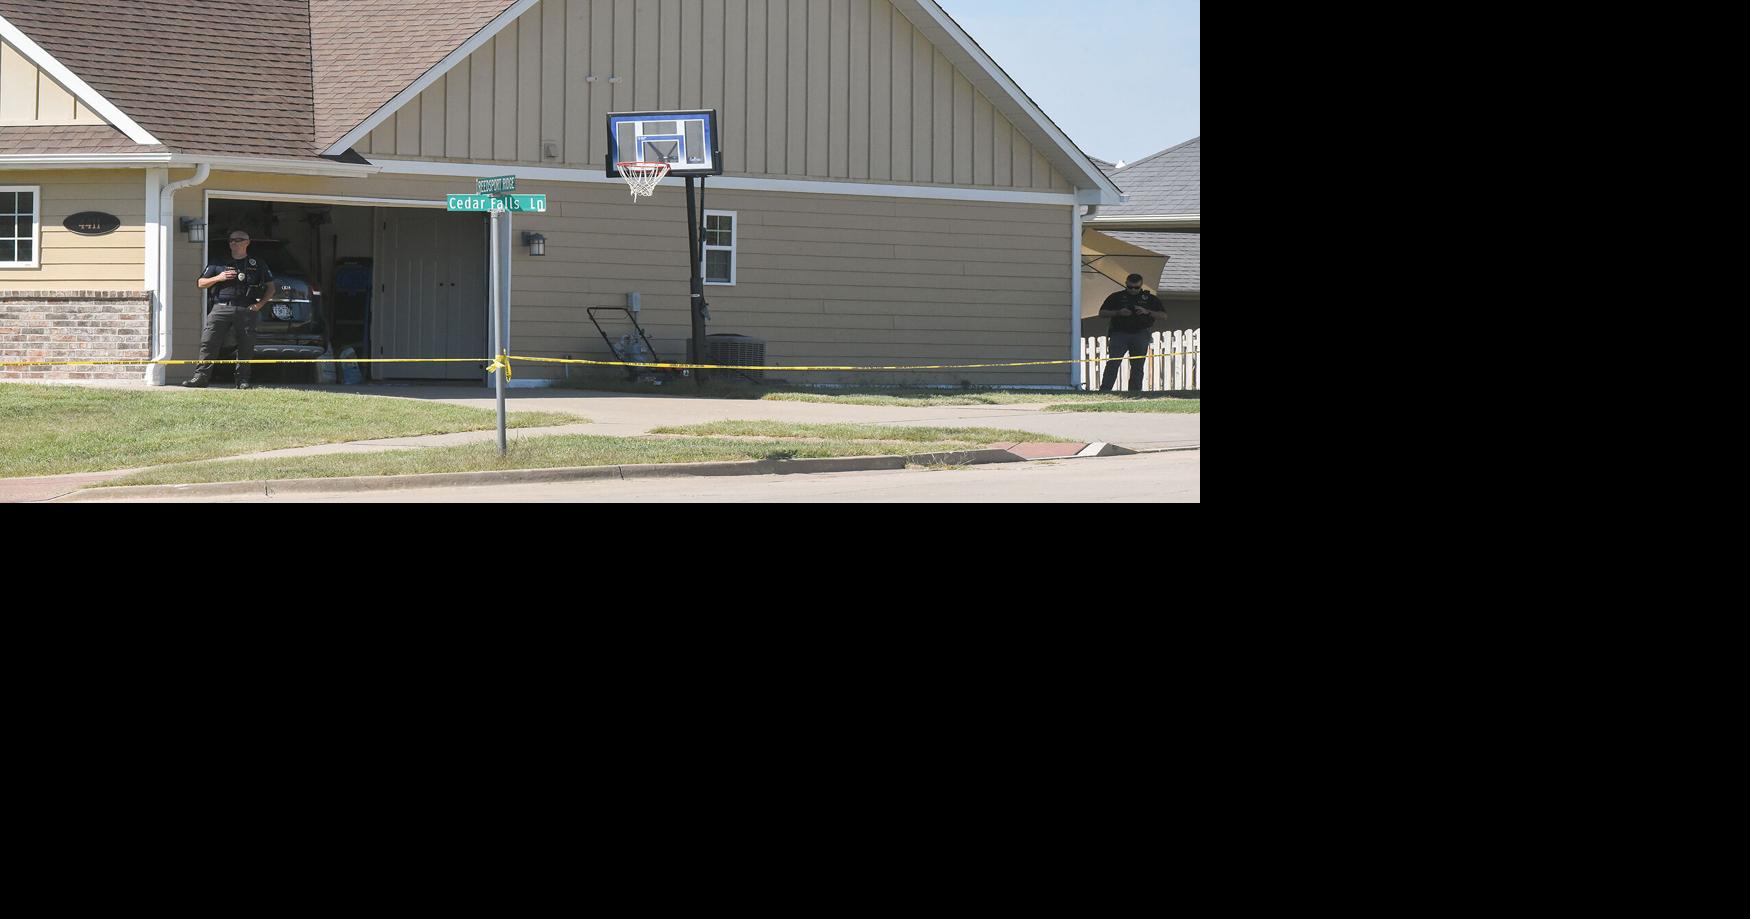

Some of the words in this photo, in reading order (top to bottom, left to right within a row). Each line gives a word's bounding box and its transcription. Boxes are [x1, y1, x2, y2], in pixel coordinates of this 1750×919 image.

[449, 197, 485, 209] Cedar
[491, 197, 520, 209] Falls
[530, 197, 545, 210] Ln
